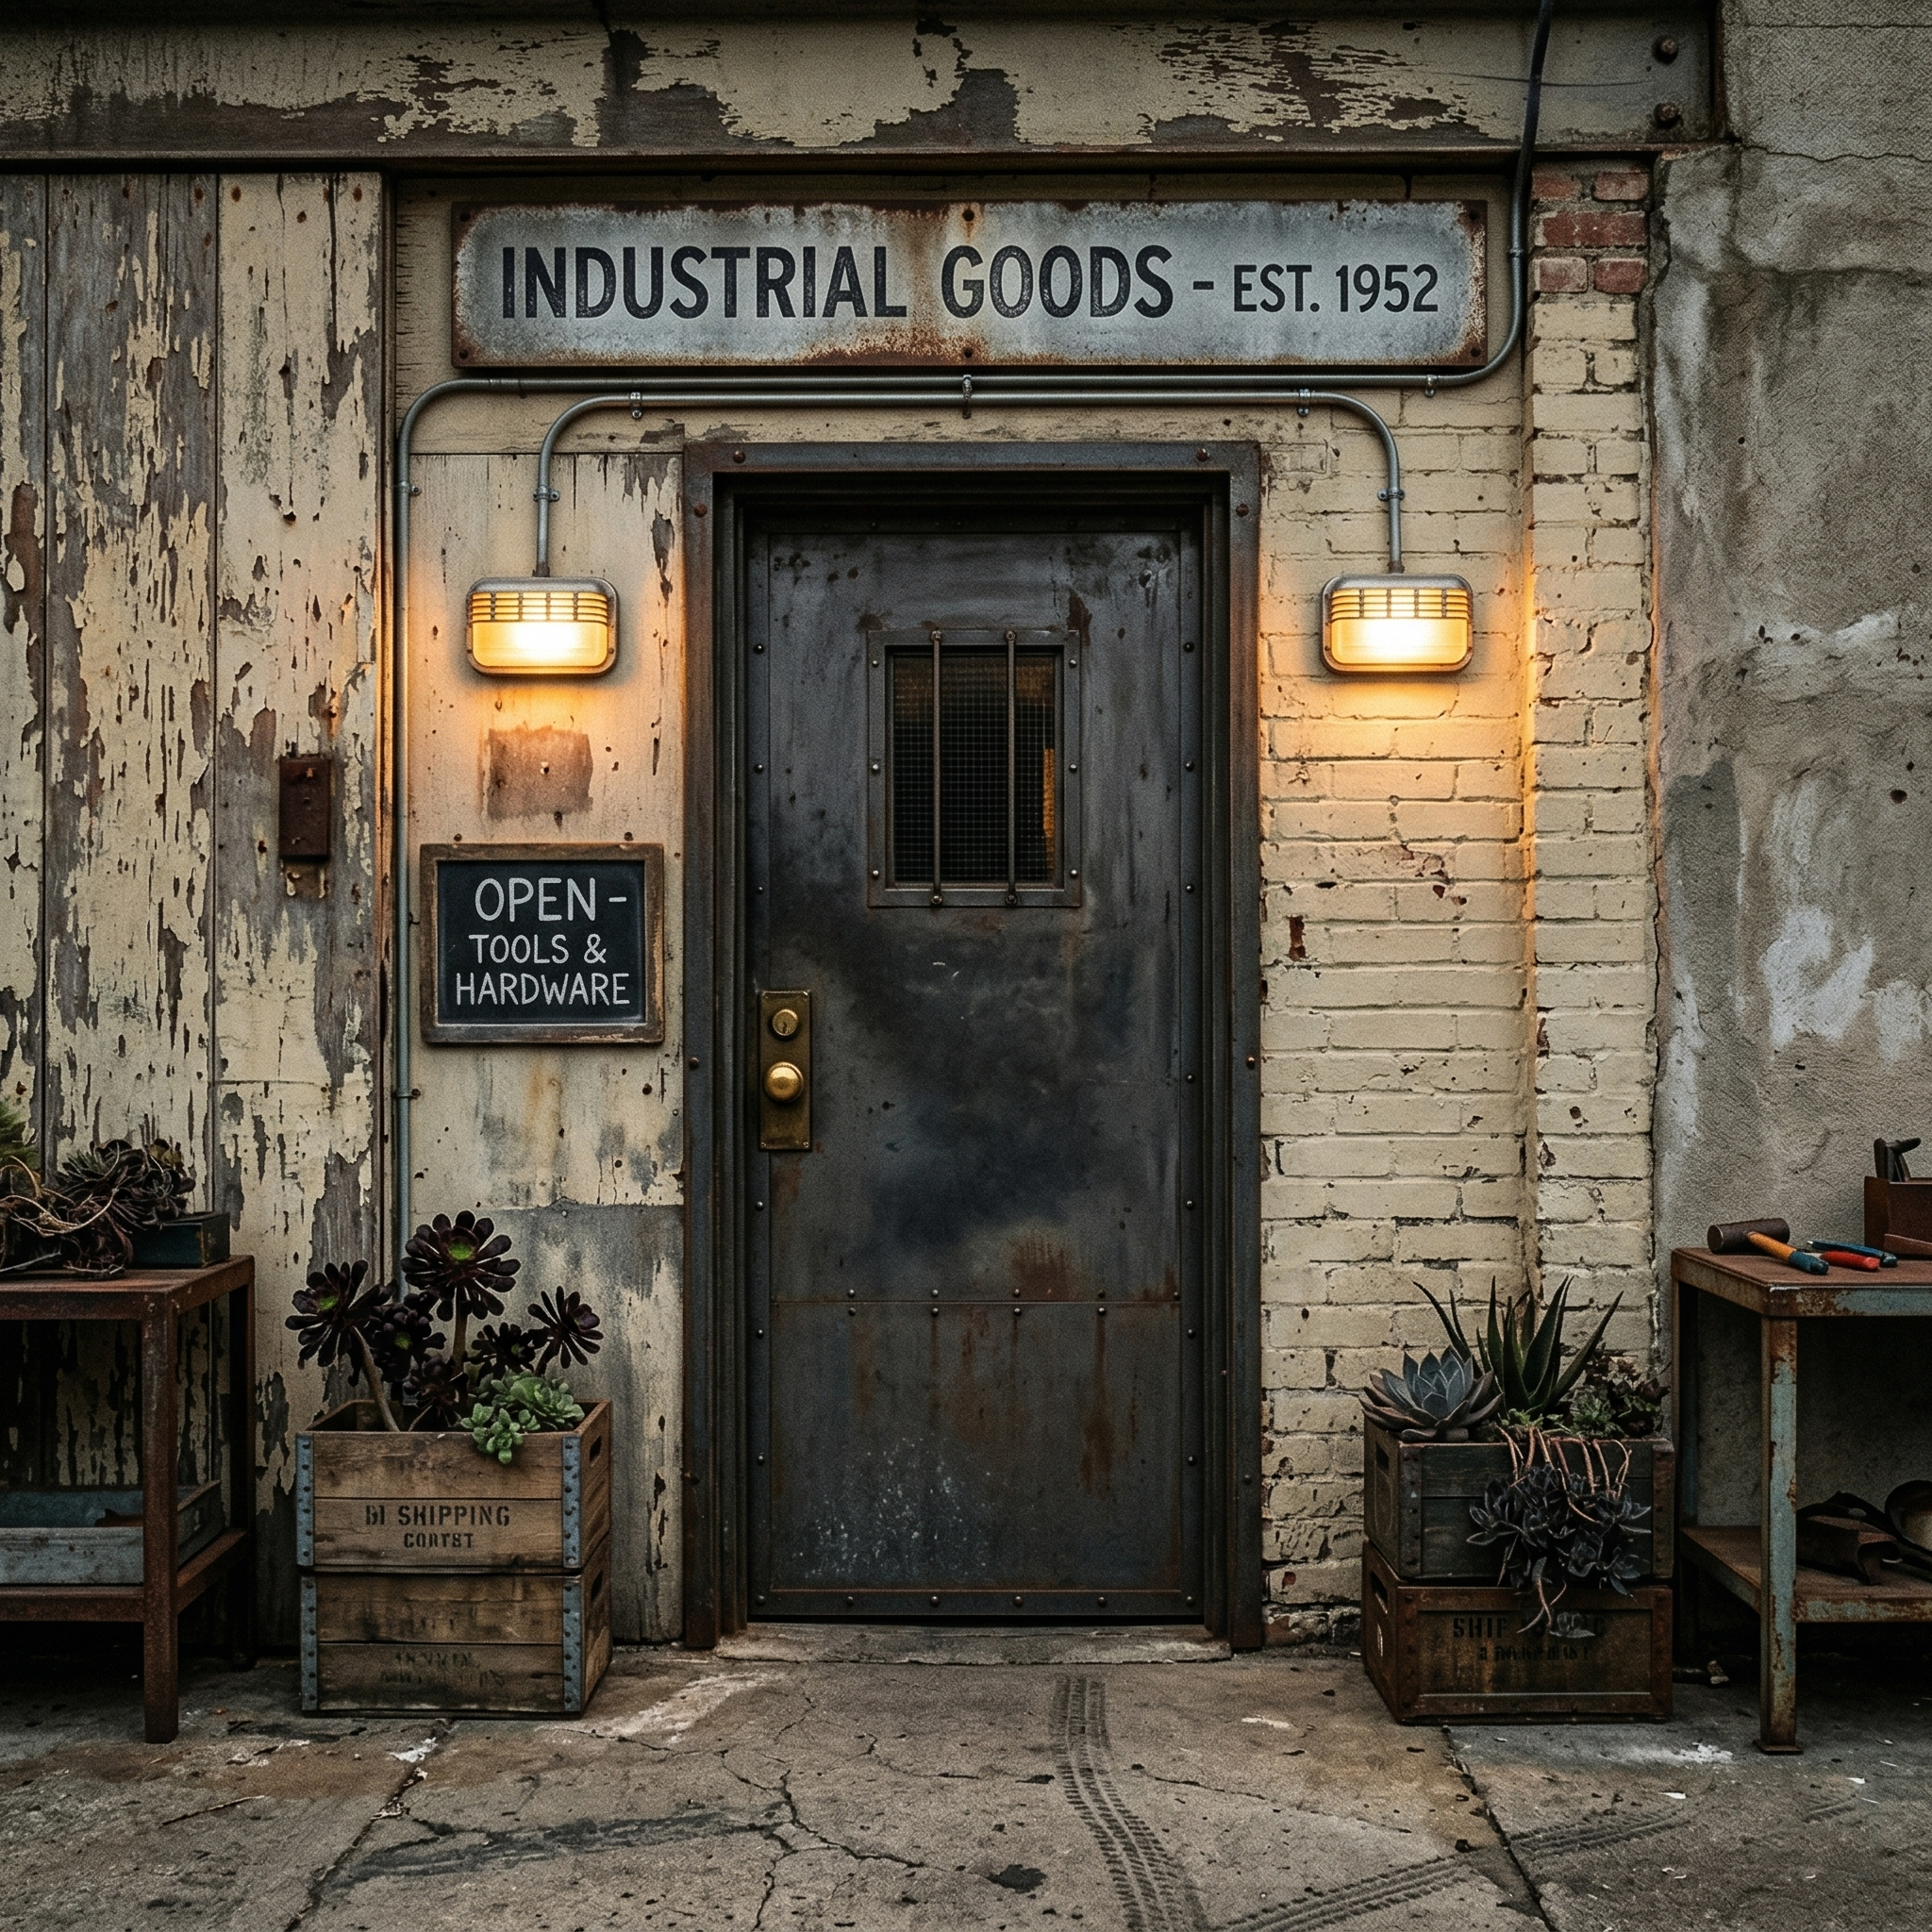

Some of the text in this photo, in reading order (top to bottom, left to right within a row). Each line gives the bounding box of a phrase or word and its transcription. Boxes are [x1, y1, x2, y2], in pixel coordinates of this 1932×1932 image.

[502, 245, 908, 319] INDUSTRIAL
[941, 244, 1174, 319] GOODS
[1233, 264, 1321, 312] EST.
[1336, 263, 1439, 313] 1952
[475, 877, 596, 922] OPEN
[468, 933, 607, 964] TOOLS &
[456, 972, 630, 1006] HARDWARE
[398, 1505, 510, 1526] SHIPPING
